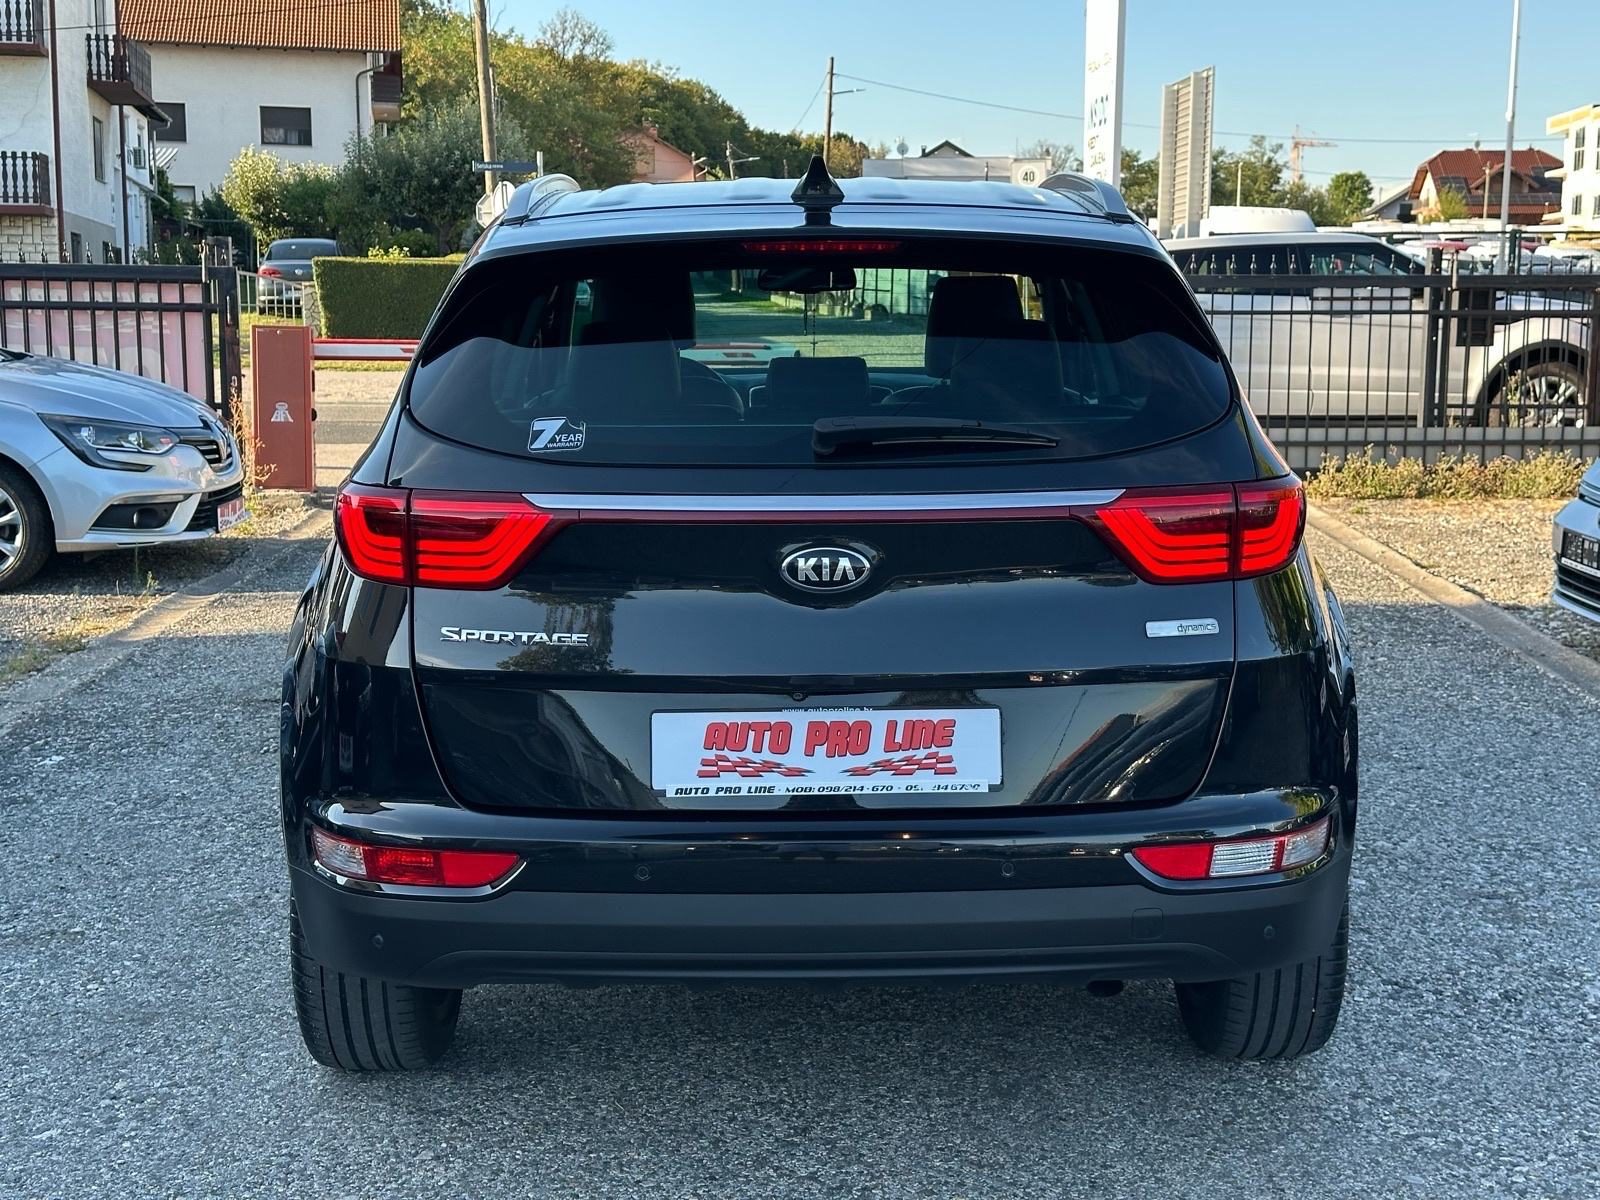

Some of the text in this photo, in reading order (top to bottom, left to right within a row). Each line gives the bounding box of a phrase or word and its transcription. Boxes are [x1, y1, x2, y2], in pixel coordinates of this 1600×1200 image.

[1022, 171, 1035, 183] 40
[530, 419, 583, 449] 7 YEAR
[796, 557, 856, 582] KIA
[439, 626, 589, 647] SPORTAGE
[1176, 623, 1217, 635] dynamics
[703, 718, 956, 758] AUTO PRO LINE
[674, 787, 710, 796] AUTO
[715, 786, 742, 795] PRO
[747, 785, 776, 794] LINE
